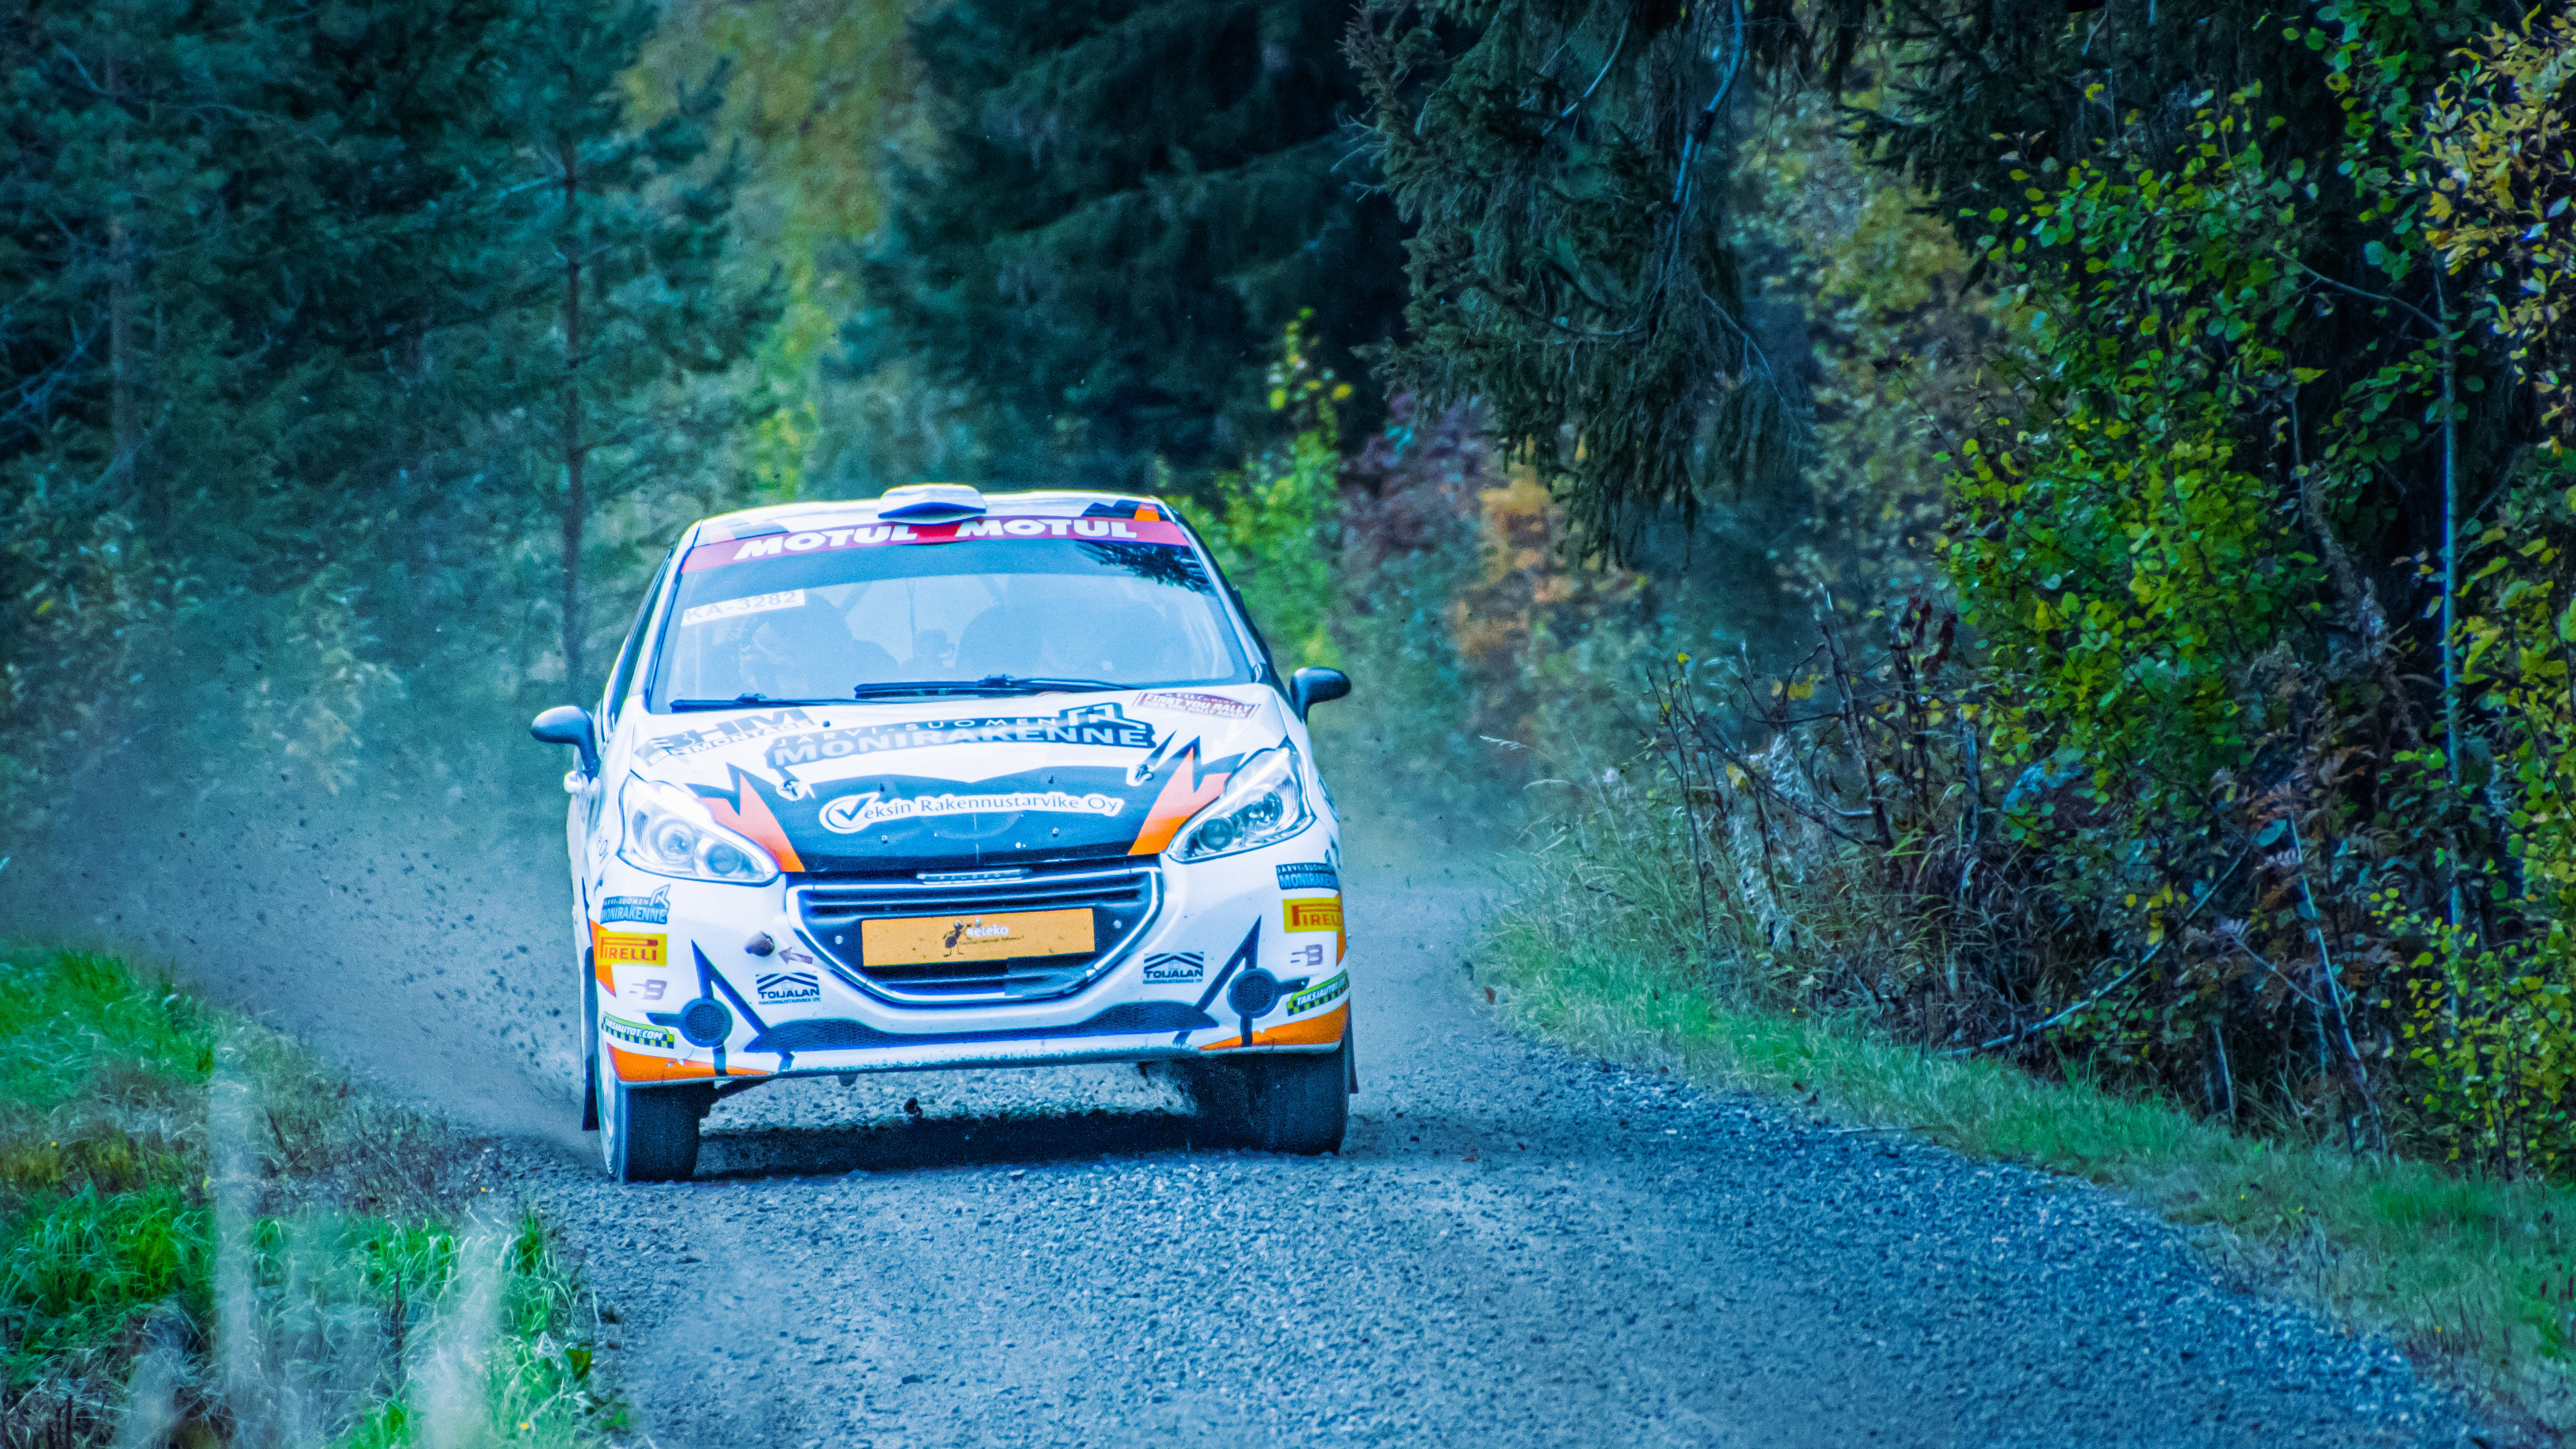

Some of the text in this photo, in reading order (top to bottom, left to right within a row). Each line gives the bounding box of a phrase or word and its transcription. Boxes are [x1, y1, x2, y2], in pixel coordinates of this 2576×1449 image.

[955, 519, 1137, 539] MOTUL
[733, 525, 919, 560] MOTUL
[685, 591, 796, 621] KA-3282
[1185, 699, 1211, 709] YOU
[1212, 703, 1252, 712] RALLY
[774, 727, 1148, 765] MONIRAKENNE
[921, 795, 1079, 812] Rakennustarvike
[1088, 797, 1118, 812] Oy
[1292, 905, 1343, 927] PIRELL
[600, 937, 658, 961] PIRELLI
[1144, 969, 1203, 978] TOIJALAN
[760, 989, 820, 999] TOIJALAN
